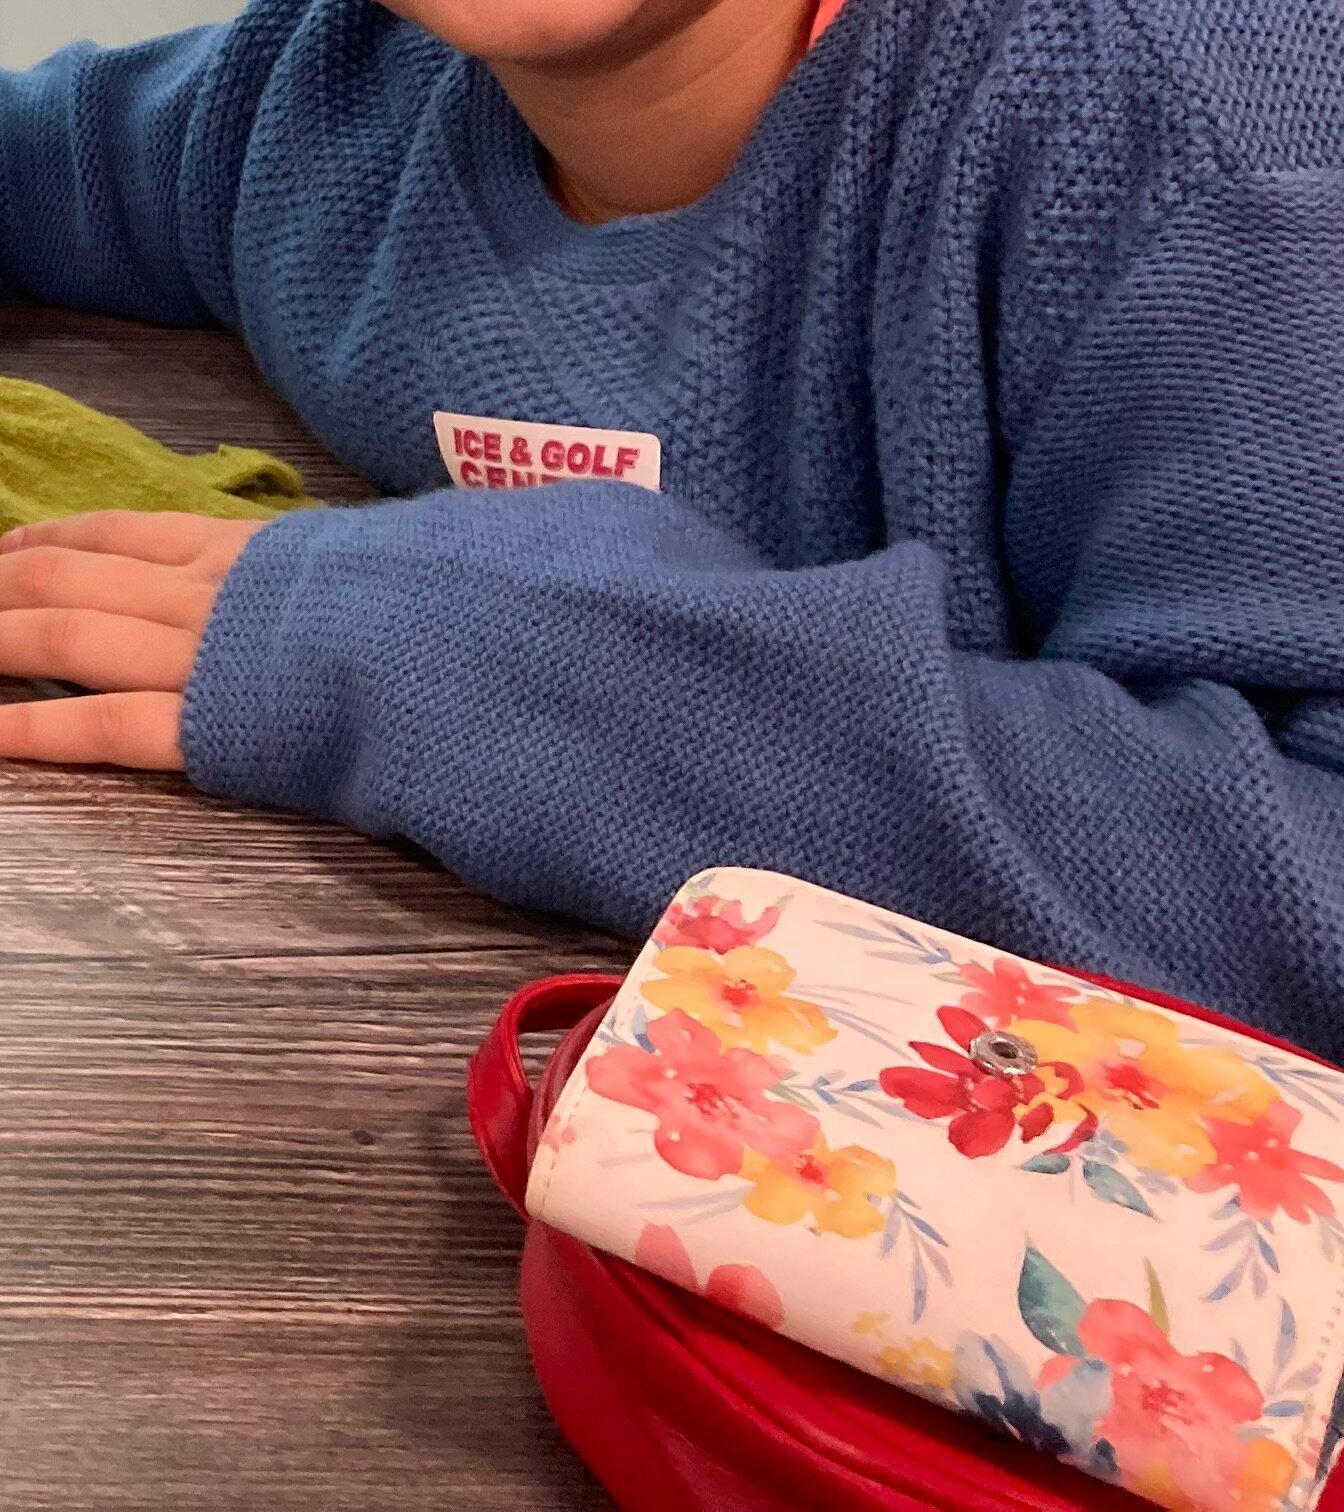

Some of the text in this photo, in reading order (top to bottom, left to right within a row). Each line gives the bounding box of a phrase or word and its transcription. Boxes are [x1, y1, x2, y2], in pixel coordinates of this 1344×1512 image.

[452, 426, 641, 478] ICE & GOLF
